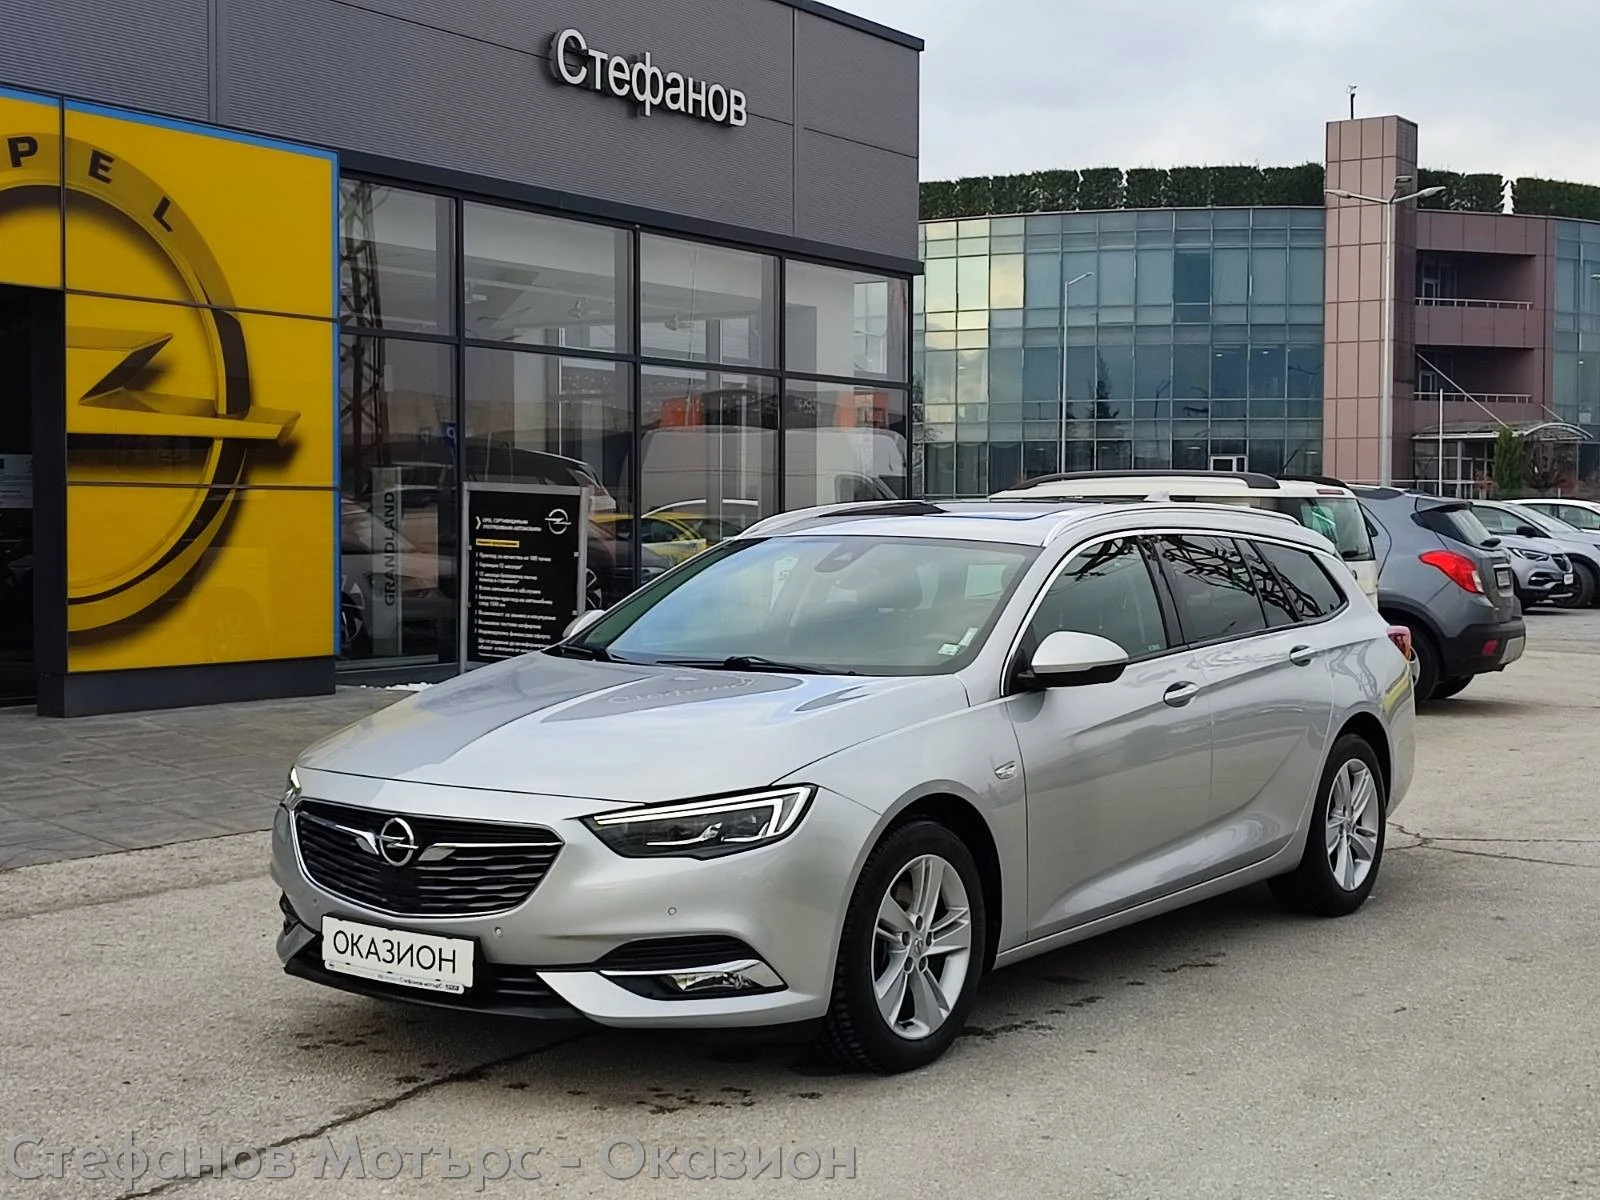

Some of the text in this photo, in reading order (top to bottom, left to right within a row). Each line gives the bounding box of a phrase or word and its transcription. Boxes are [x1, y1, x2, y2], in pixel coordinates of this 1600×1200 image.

[557, 28, 747, 127] Стефанов
[384, 491, 395, 606] GRANDLAND
[333, 930, 456, 974] ОКАЗИОН
